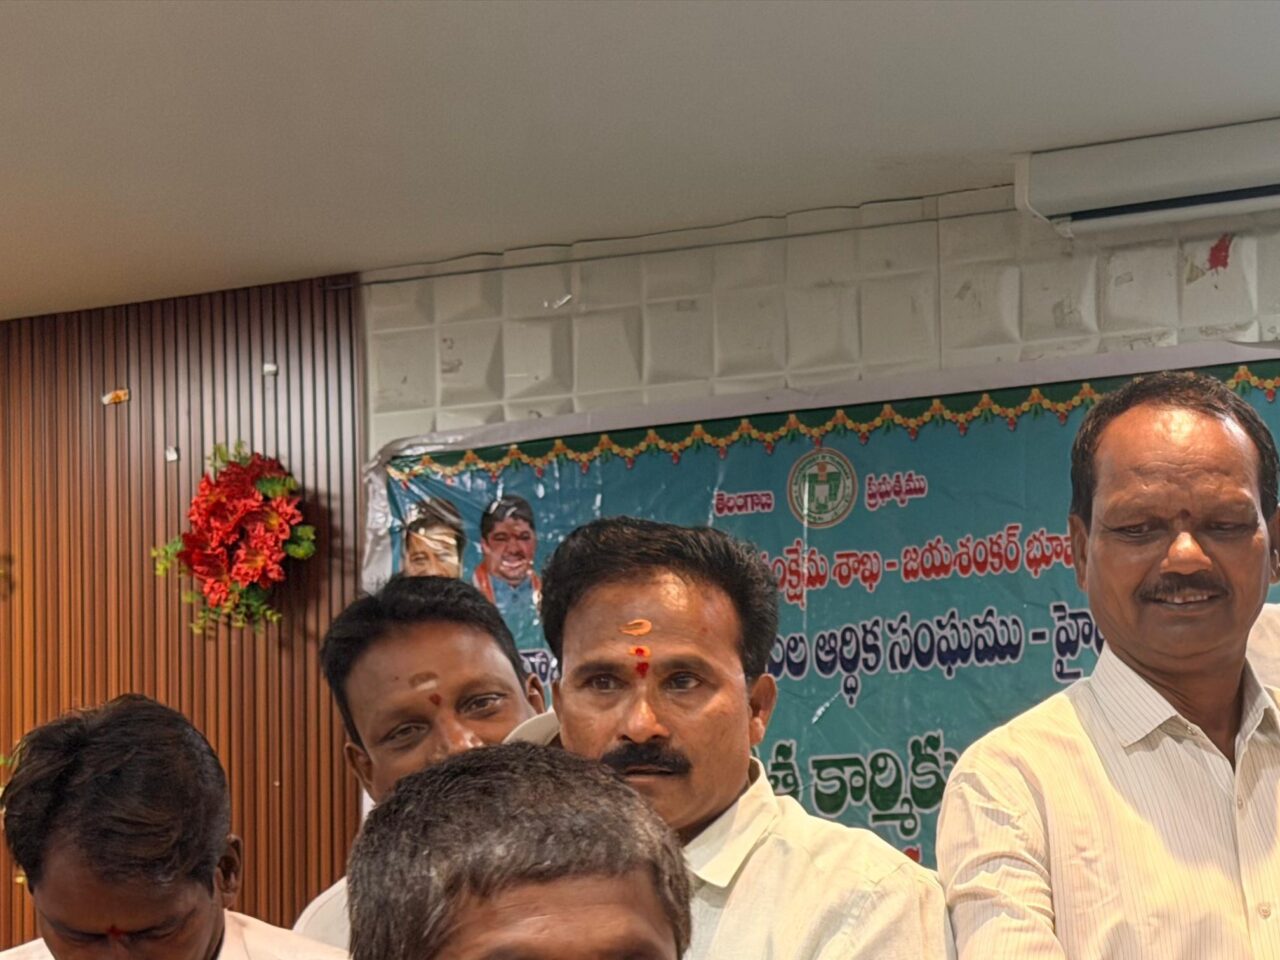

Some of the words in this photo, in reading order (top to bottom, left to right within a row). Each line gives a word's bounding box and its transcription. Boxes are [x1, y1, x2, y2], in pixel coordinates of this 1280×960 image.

[714, 492, 775, 515] తెలంగాణ
[866, 471, 927, 510] ప్రభుత్వము
[833, 551, 880, 591] శాఖ
[903, 525, 1021, 582] జయశంకర్
[888, 608, 1022, 677] సంఘము
